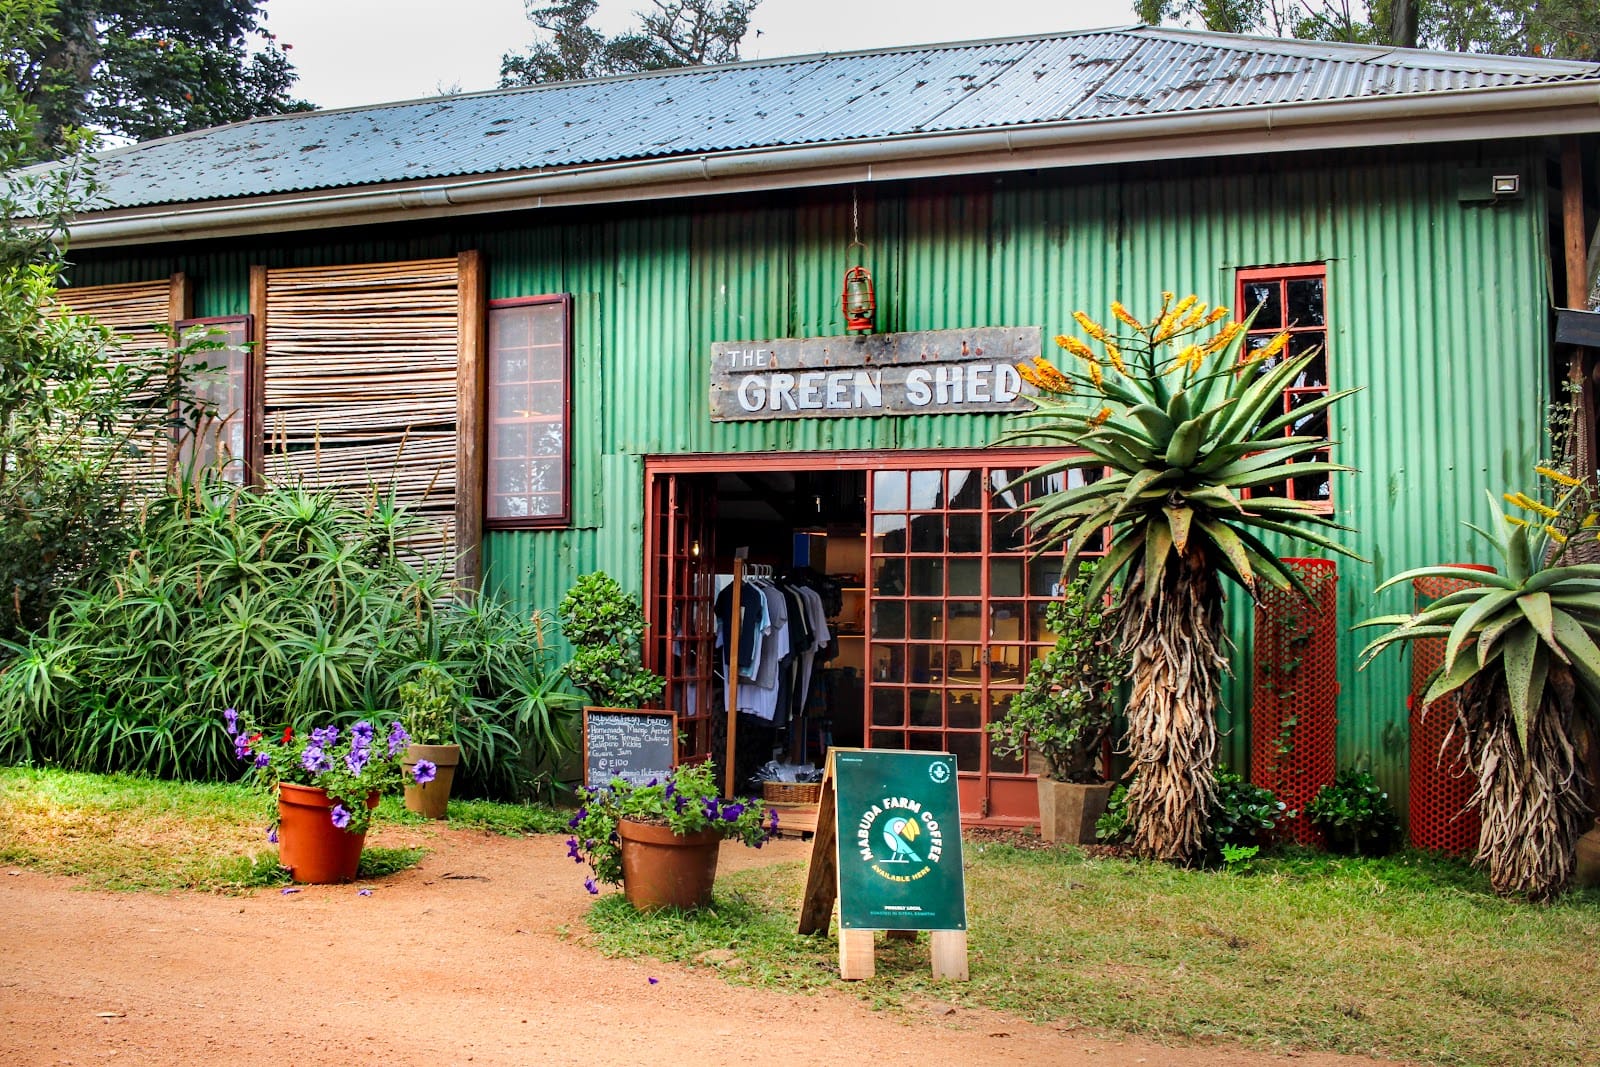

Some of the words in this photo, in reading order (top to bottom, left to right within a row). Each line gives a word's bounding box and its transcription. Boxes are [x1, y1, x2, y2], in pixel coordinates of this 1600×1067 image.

[727, 350, 767, 367] THE
[737, 371, 882, 412] GREEN
[905, 363, 1023, 406] SHED
[857, 804, 883, 861] MABUDA
[882, 797, 922, 813] FARM
[920, 811, 943, 863] COFFEE
[871, 864, 910, 882] AVAILABLE
[911, 866, 931, 880] HERE
